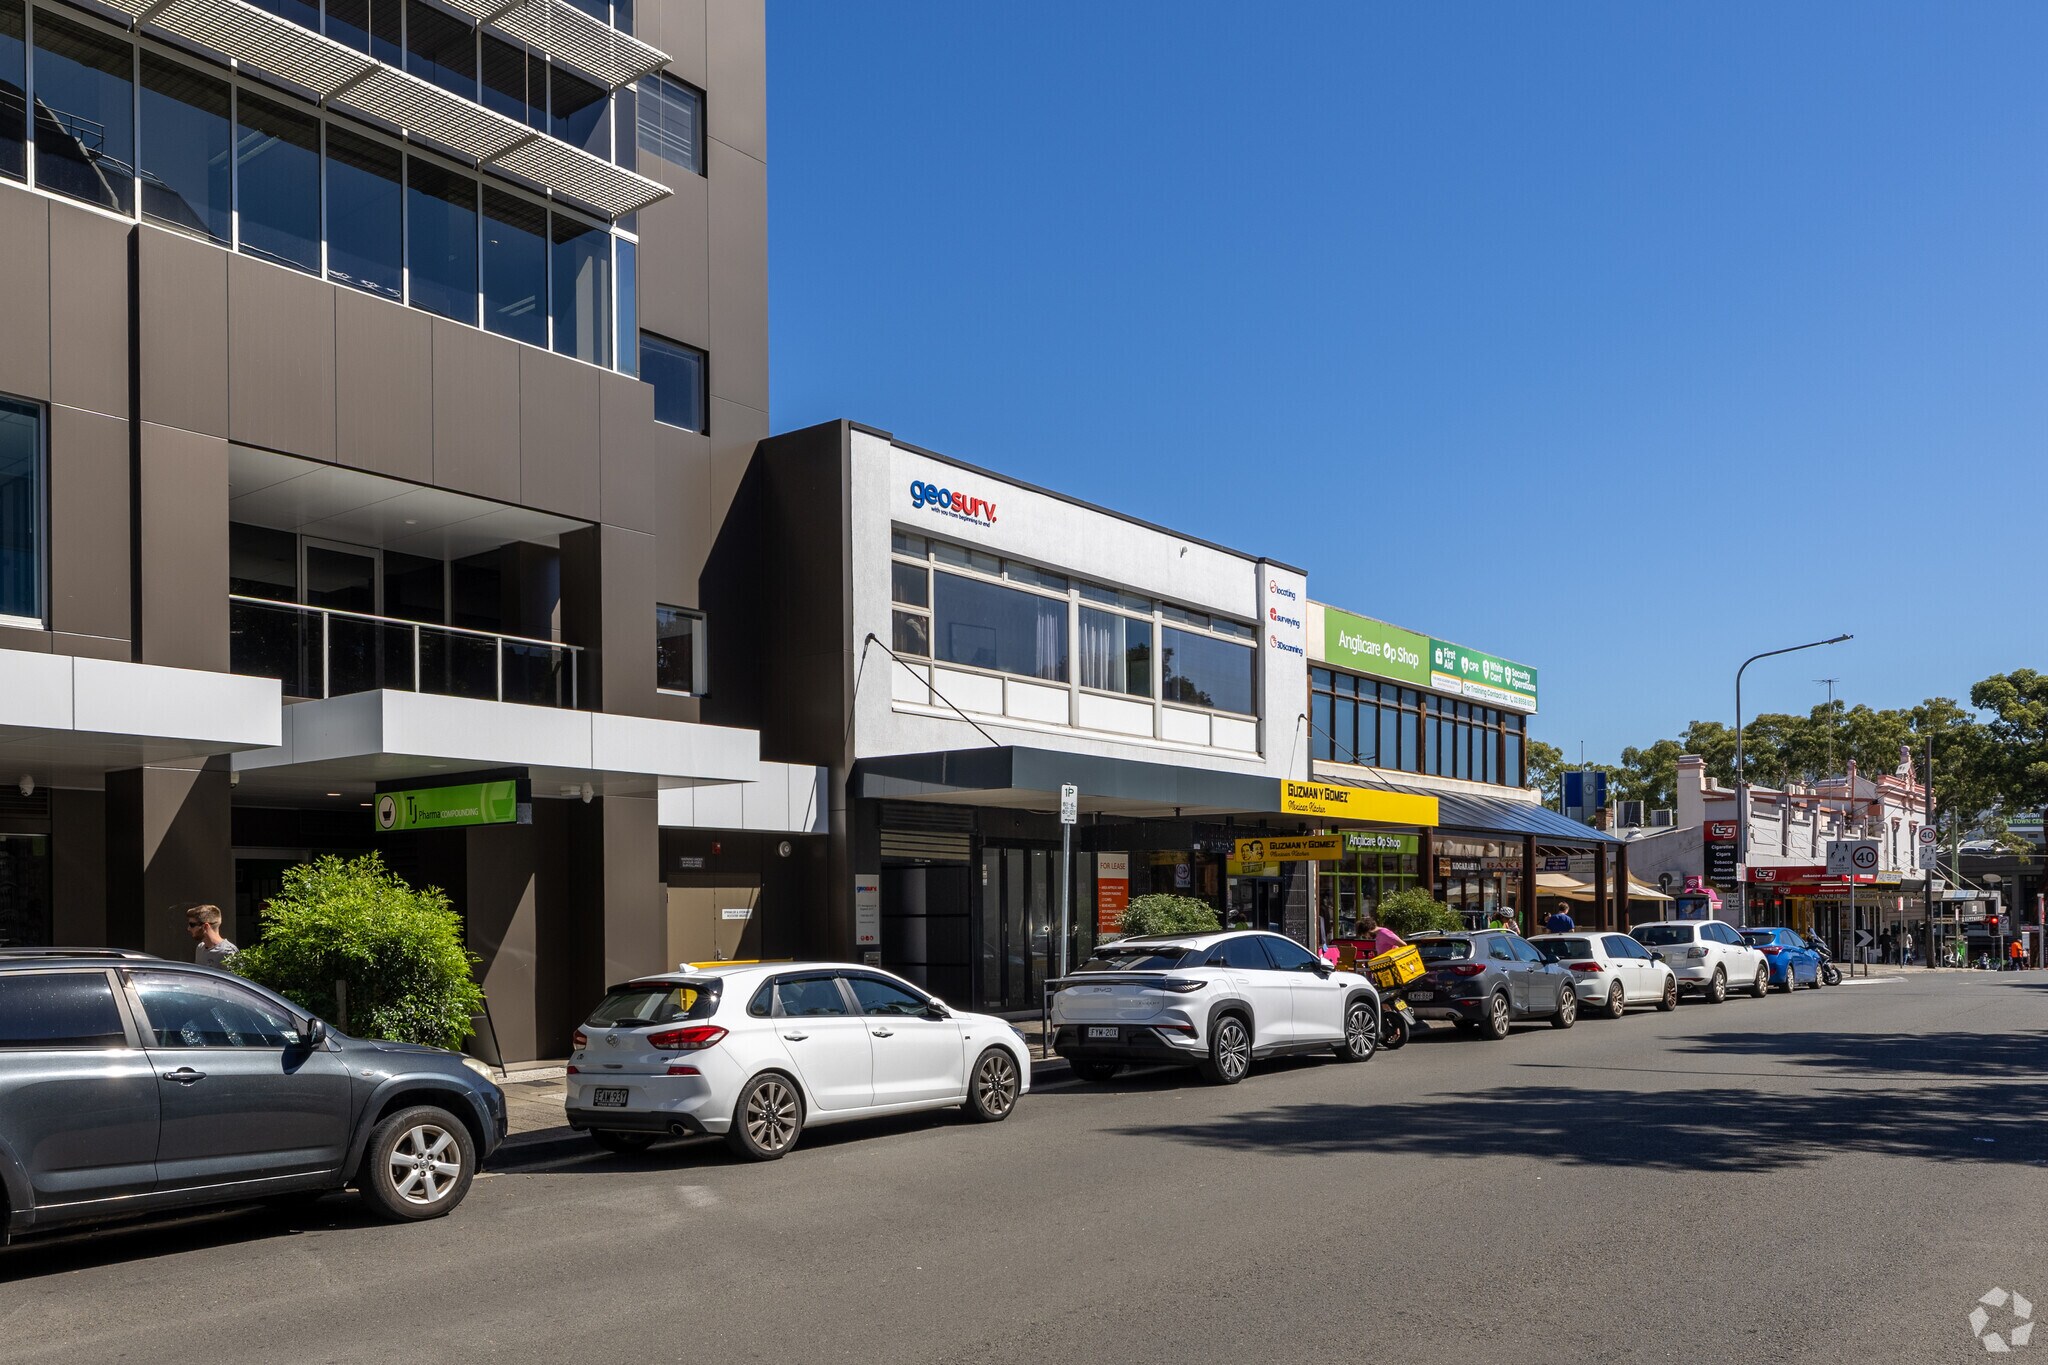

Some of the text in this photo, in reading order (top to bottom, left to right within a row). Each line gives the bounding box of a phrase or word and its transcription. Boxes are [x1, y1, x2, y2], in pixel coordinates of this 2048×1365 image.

[959, 513, 977, 525] beginning
[1276, 586, 1296, 601] locating
[1277, 614, 1300, 629] surveying
[1339, 630, 1419, 669] Anglicare Op Shop
[1443, 647, 1456, 660] First
[1444, 659, 1454, 670] Aid
[1469, 661, 1479, 672] CPR
[1490, 661, 1503, 673] White
[1490, 671, 1502, 683] Card
[1511, 668, 1530, 683] Security
[1512, 677, 1536, 692] Operations
[1064, 786, 1074, 797] 1P
[1288, 783, 1318, 799] GUZMAN
[1318, 788, 1324, 800] Y
[1288, 799, 1326, 814] Mexican Kitchen
[419, 810, 441, 820] Pharma
[441, 807, 479, 818] COMPOUNDING
[1712, 823, 1736, 838] tsg
[1922, 831, 1933, 839] 40
[1270, 841, 1301, 850] GUZMAN
[1302, 841, 1307, 849] Y
[1349, 834, 1401, 850] Anglicare Op Shop
[1856, 852, 1874, 863] 40
[1755, 868, 1776, 880] tsg
